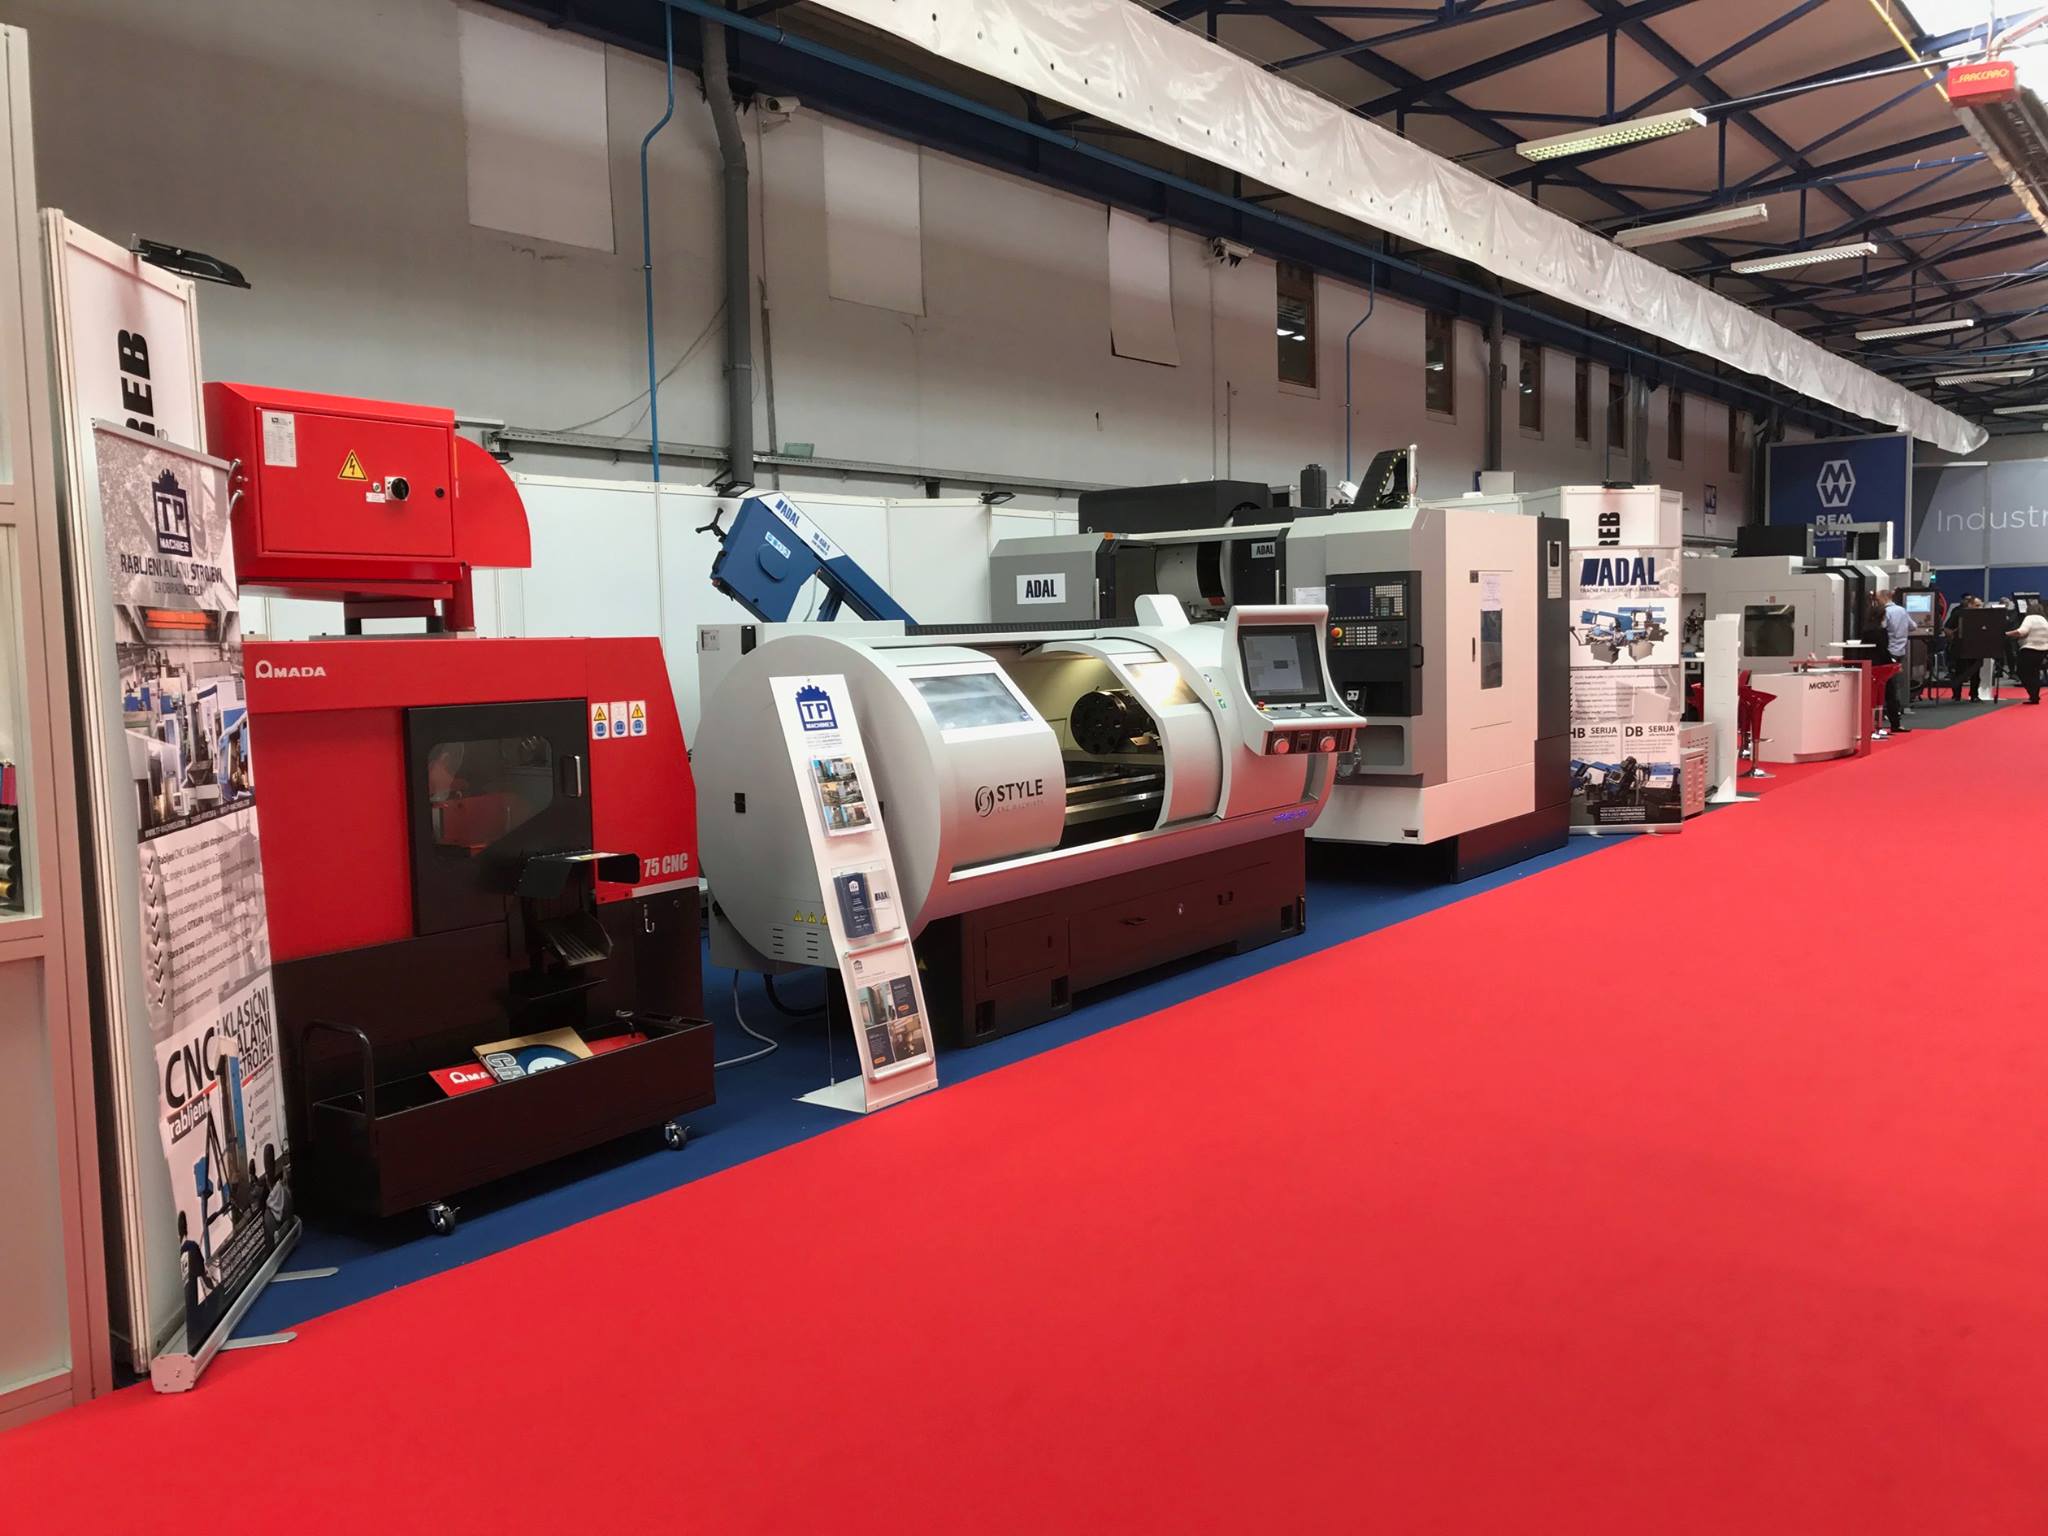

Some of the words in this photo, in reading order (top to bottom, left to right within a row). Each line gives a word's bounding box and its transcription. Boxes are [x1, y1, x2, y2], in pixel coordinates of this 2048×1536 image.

[158, 496, 185, 533] TP
[780, 504, 800, 529] ADAL
[1816, 513, 1853, 526] REM
[1256, 545, 1274, 556] ADAL
[121, 554, 162, 577] RABLJENI
[164, 559, 190, 579] ALATNI
[191, 563, 223, 583] STROJEVI
[1598, 557, 1660, 586] ADAL
[1025, 579, 1057, 599] ADAL
[256, 660, 326, 678] AMADA
[802, 703, 829, 719] TP
[1590, 726, 1618, 735] SERIJA
[1625, 726, 1644, 737] DB
[1648, 725, 1675, 733] SERIJA
[996, 779, 1043, 802] STYLE
[643, 857, 659, 877] 75
[661, 853, 688, 874] CNC
[165, 1026, 215, 1108] CNC
[449, 1071, 491, 1084] AMA
[169, 1093, 211, 1137] rabljeni
